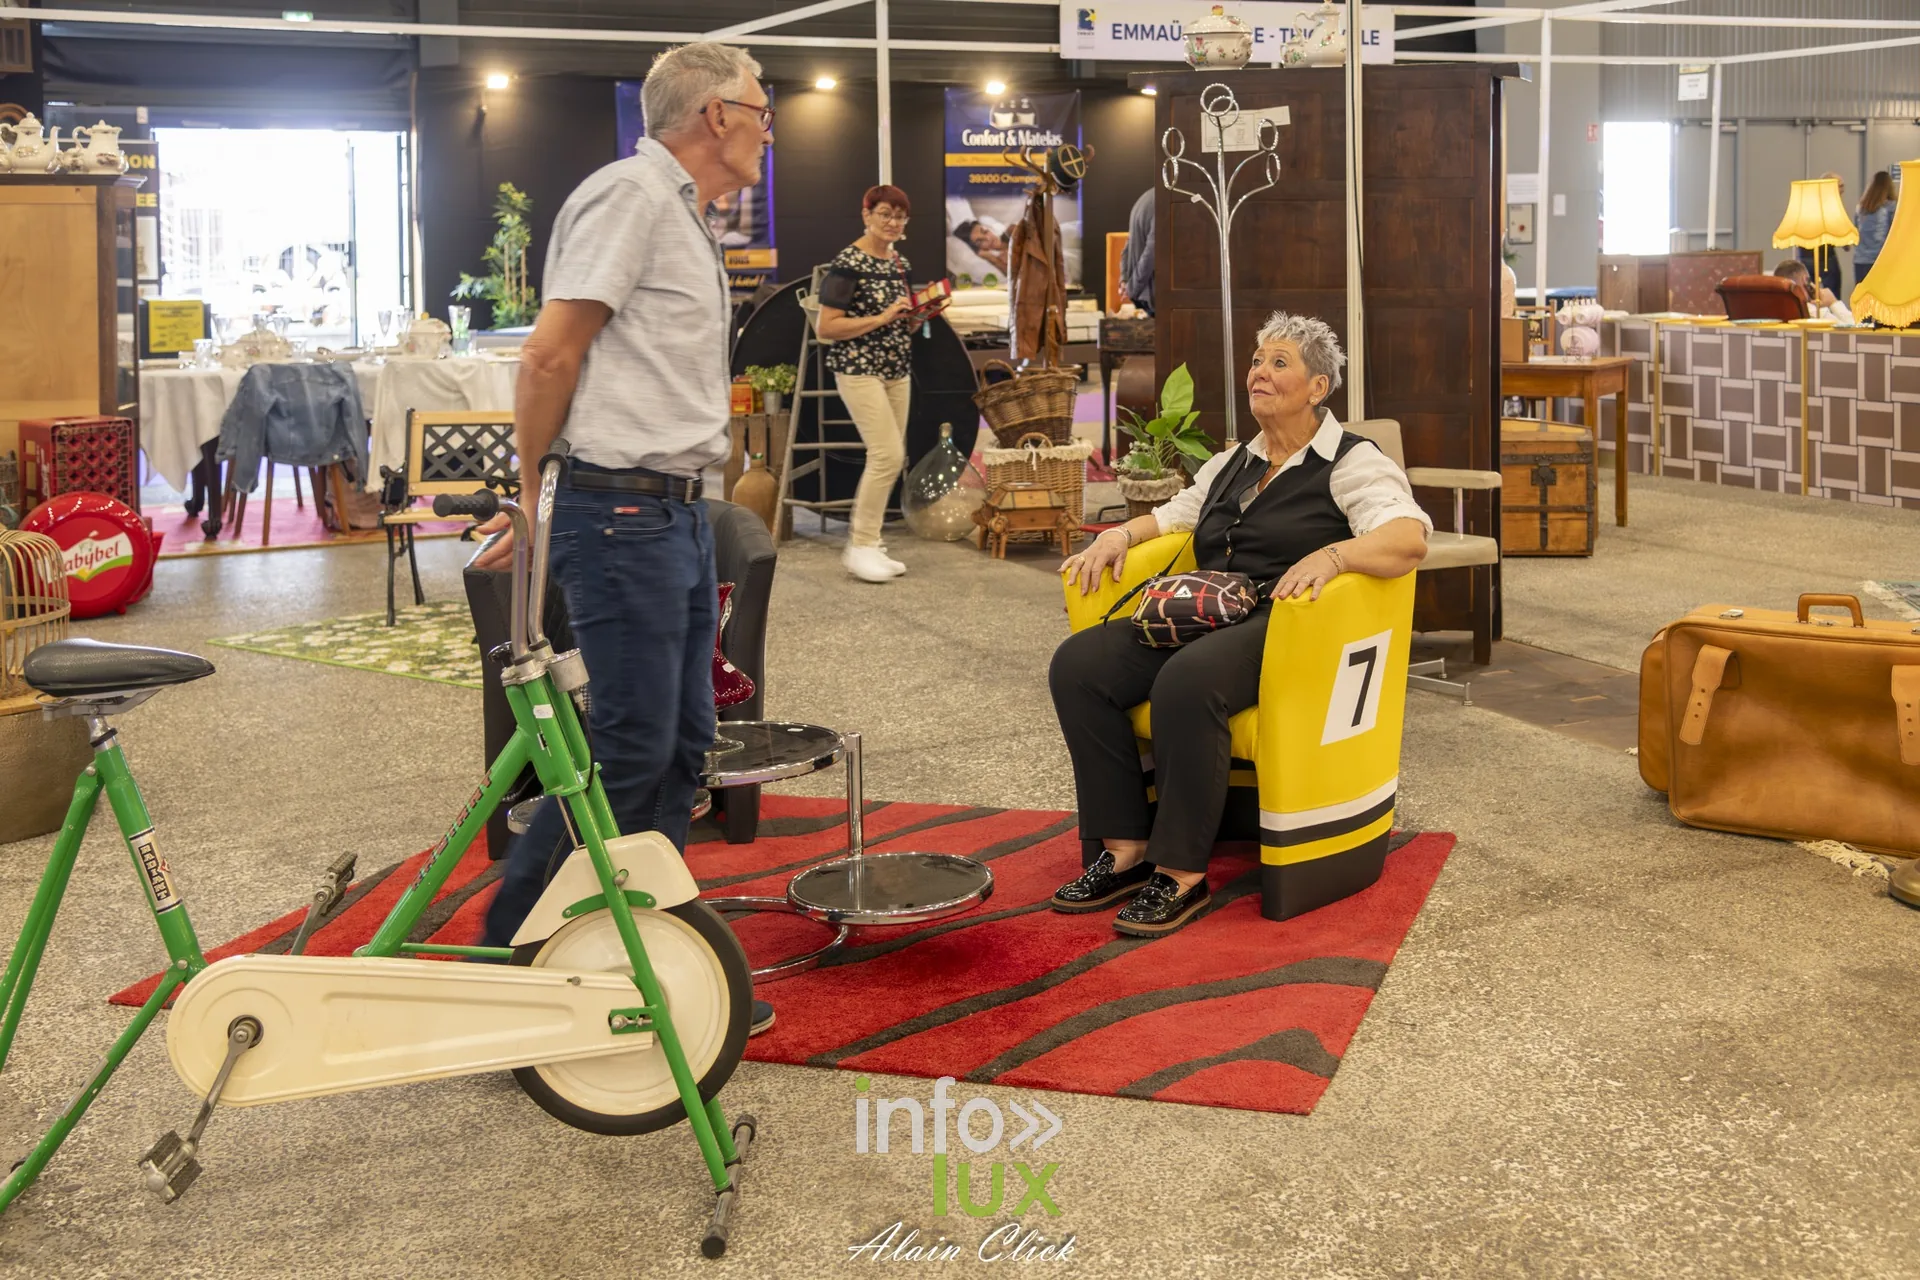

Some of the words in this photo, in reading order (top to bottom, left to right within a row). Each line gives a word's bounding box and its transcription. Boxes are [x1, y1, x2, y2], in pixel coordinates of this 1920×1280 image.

[1112, 20, 1182, 41] EMMAÜ
[962, 129, 1006, 147] Confort
[1006, 129, 1018, 147] &
[1018, 130, 1064, 147] Matelas
[54, 541, 119, 576] abybel
[1348, 645, 1377, 727] 7
